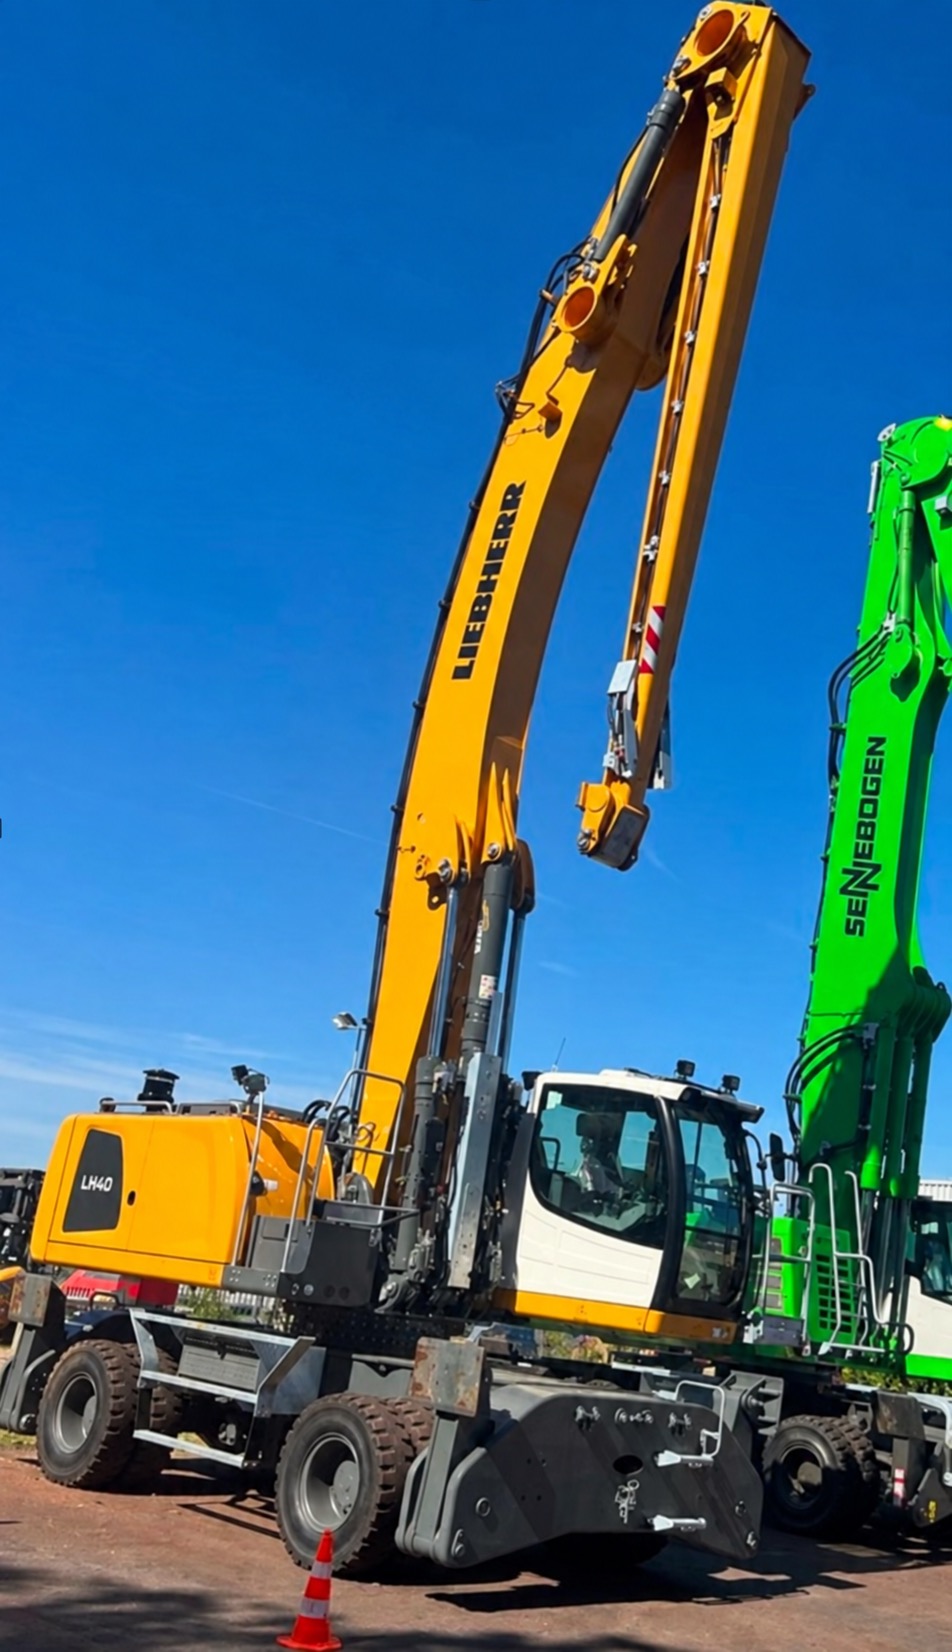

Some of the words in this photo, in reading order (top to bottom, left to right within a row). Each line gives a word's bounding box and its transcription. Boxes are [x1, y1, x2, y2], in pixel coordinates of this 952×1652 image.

[451, 480, 526, 680] LIEBHERR
[839, 736, 887, 937] SENNEBOGEN
[80, 1174, 113, 1192] LH40
